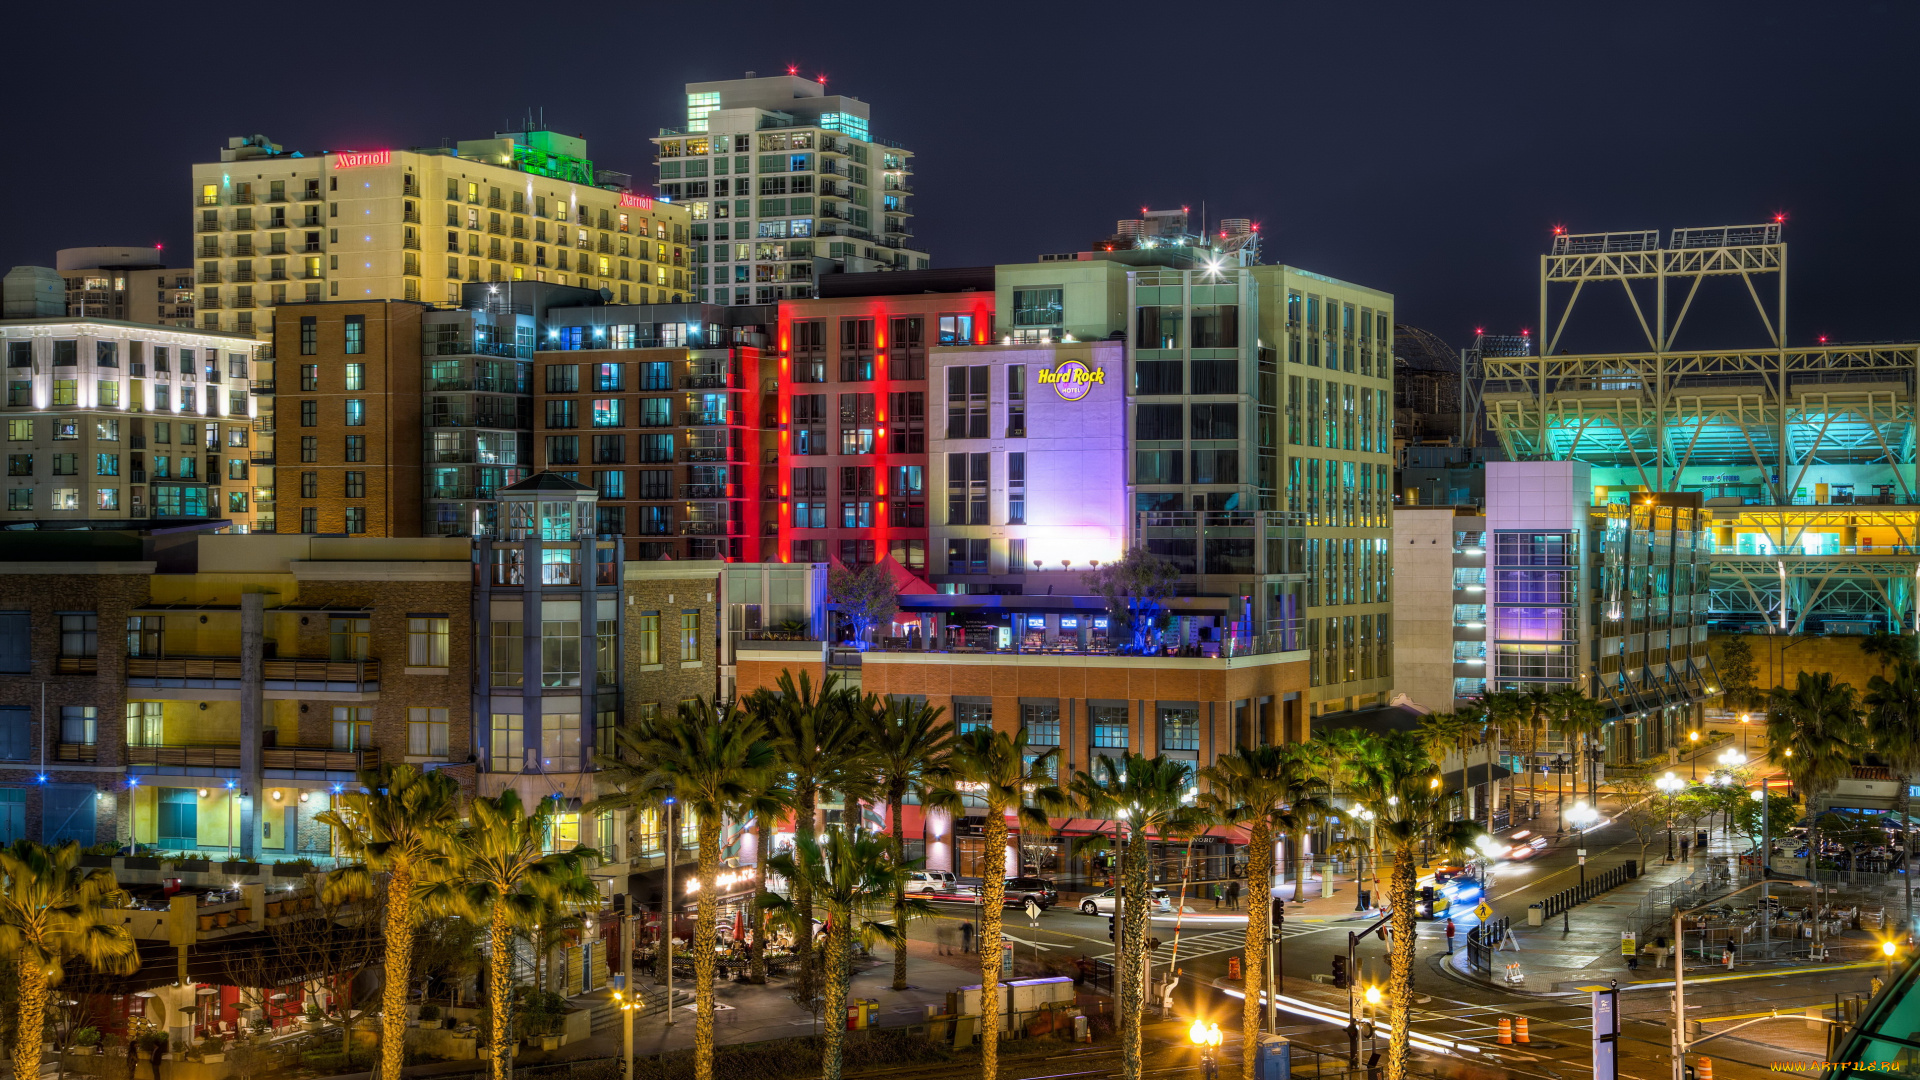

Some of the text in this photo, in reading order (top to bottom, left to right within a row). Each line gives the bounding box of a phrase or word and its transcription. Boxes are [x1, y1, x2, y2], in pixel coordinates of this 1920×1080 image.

[334, 151, 391, 169] Marriott
[619, 193, 652, 210] Marriott
[1038, 367, 1105, 385] Hard Rock
